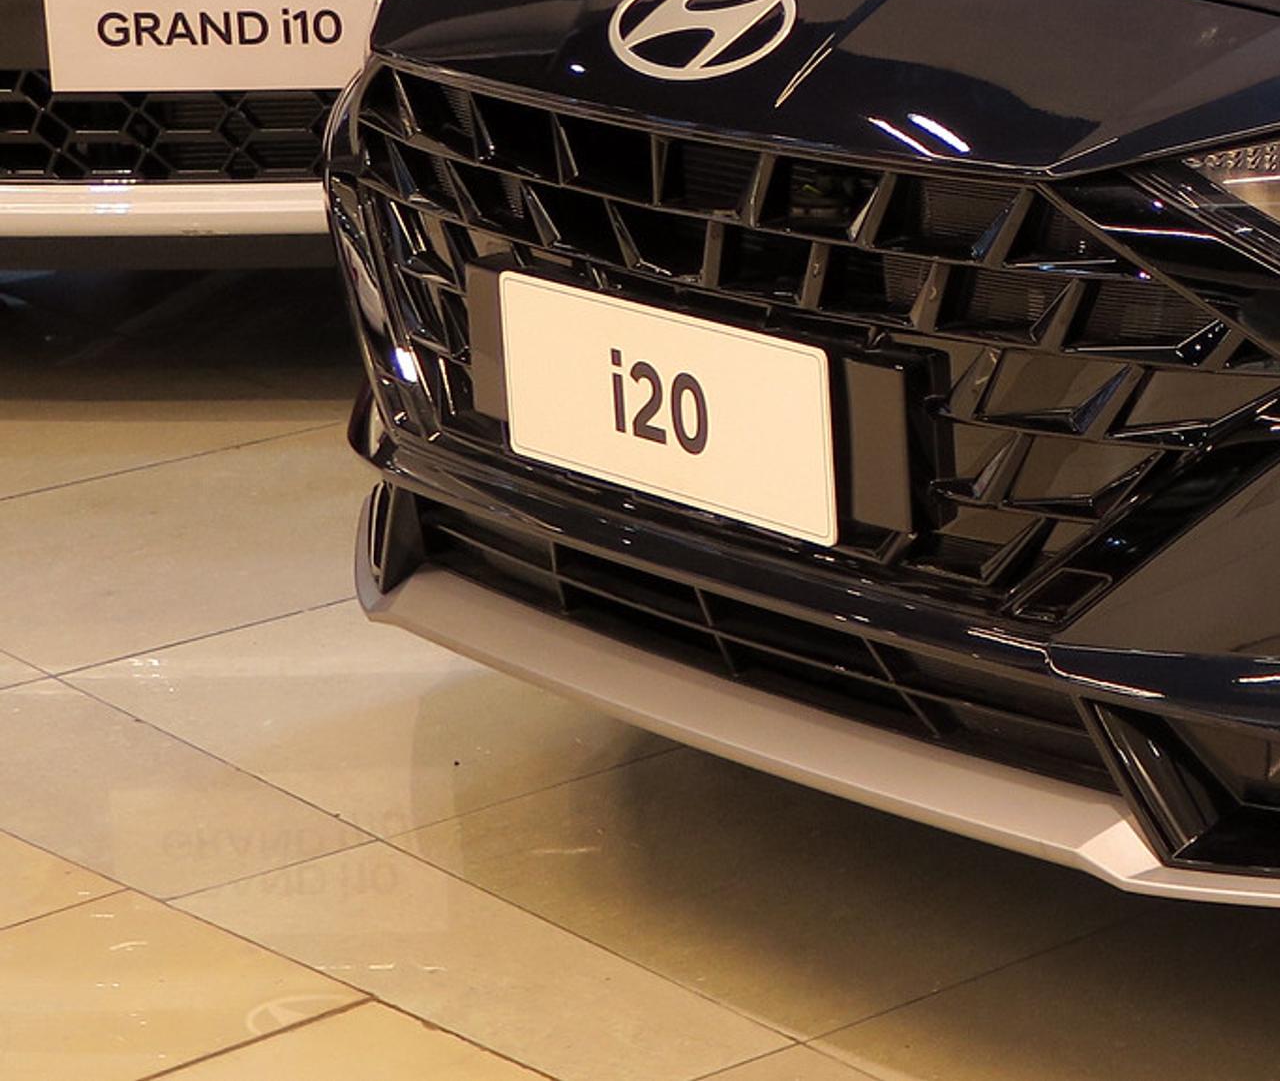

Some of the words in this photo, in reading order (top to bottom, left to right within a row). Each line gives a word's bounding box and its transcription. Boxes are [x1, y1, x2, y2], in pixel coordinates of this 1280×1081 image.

[97, 11, 269, 47] GRAND
[281, 8, 343, 45] i10
[610, 348, 709, 456] i20
